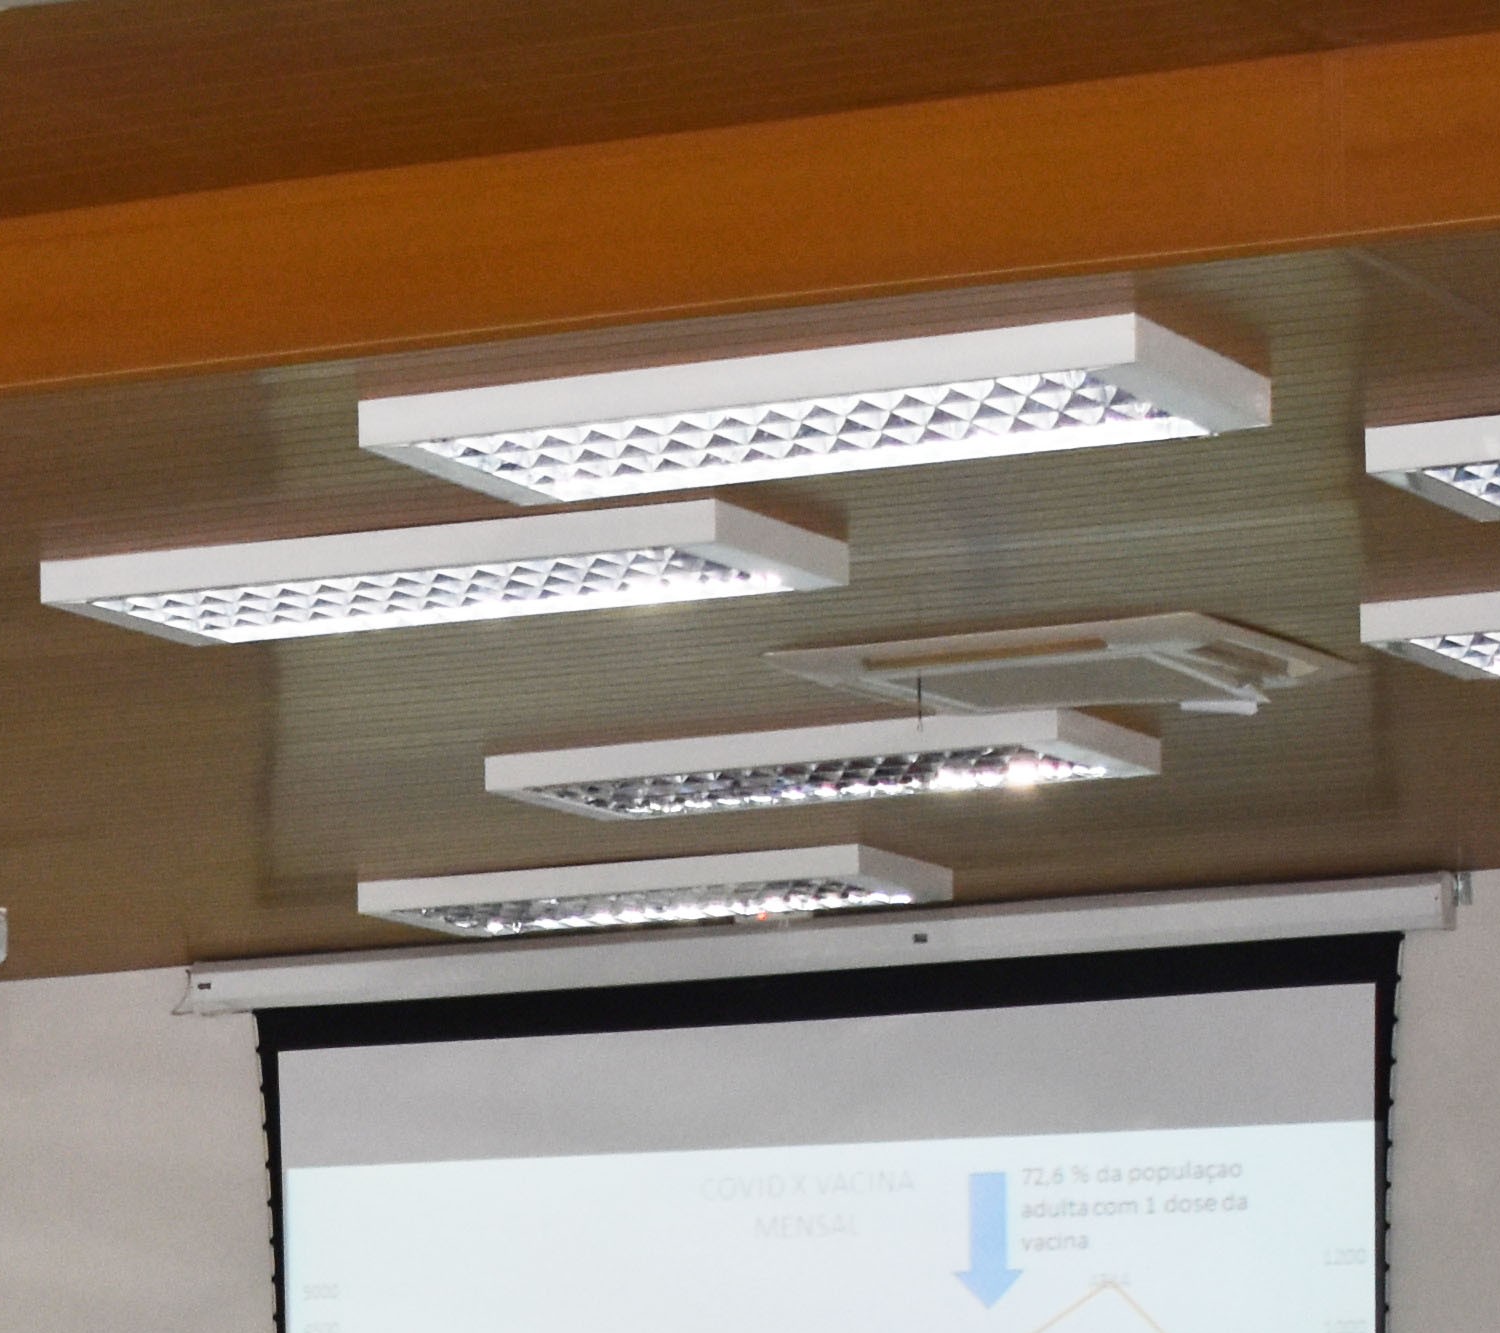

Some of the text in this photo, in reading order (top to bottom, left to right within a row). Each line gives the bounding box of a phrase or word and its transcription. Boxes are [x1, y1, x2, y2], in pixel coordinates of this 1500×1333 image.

[816, 1169, 916, 1197] VACINA
[1096, 1163, 1122, 1184] da
[1021, 1194, 1248, 1219] adulta com 1 dose da
[753, 1213, 861, 1239] MENSAL
[1021, 1233, 1089, 1252] vacina
